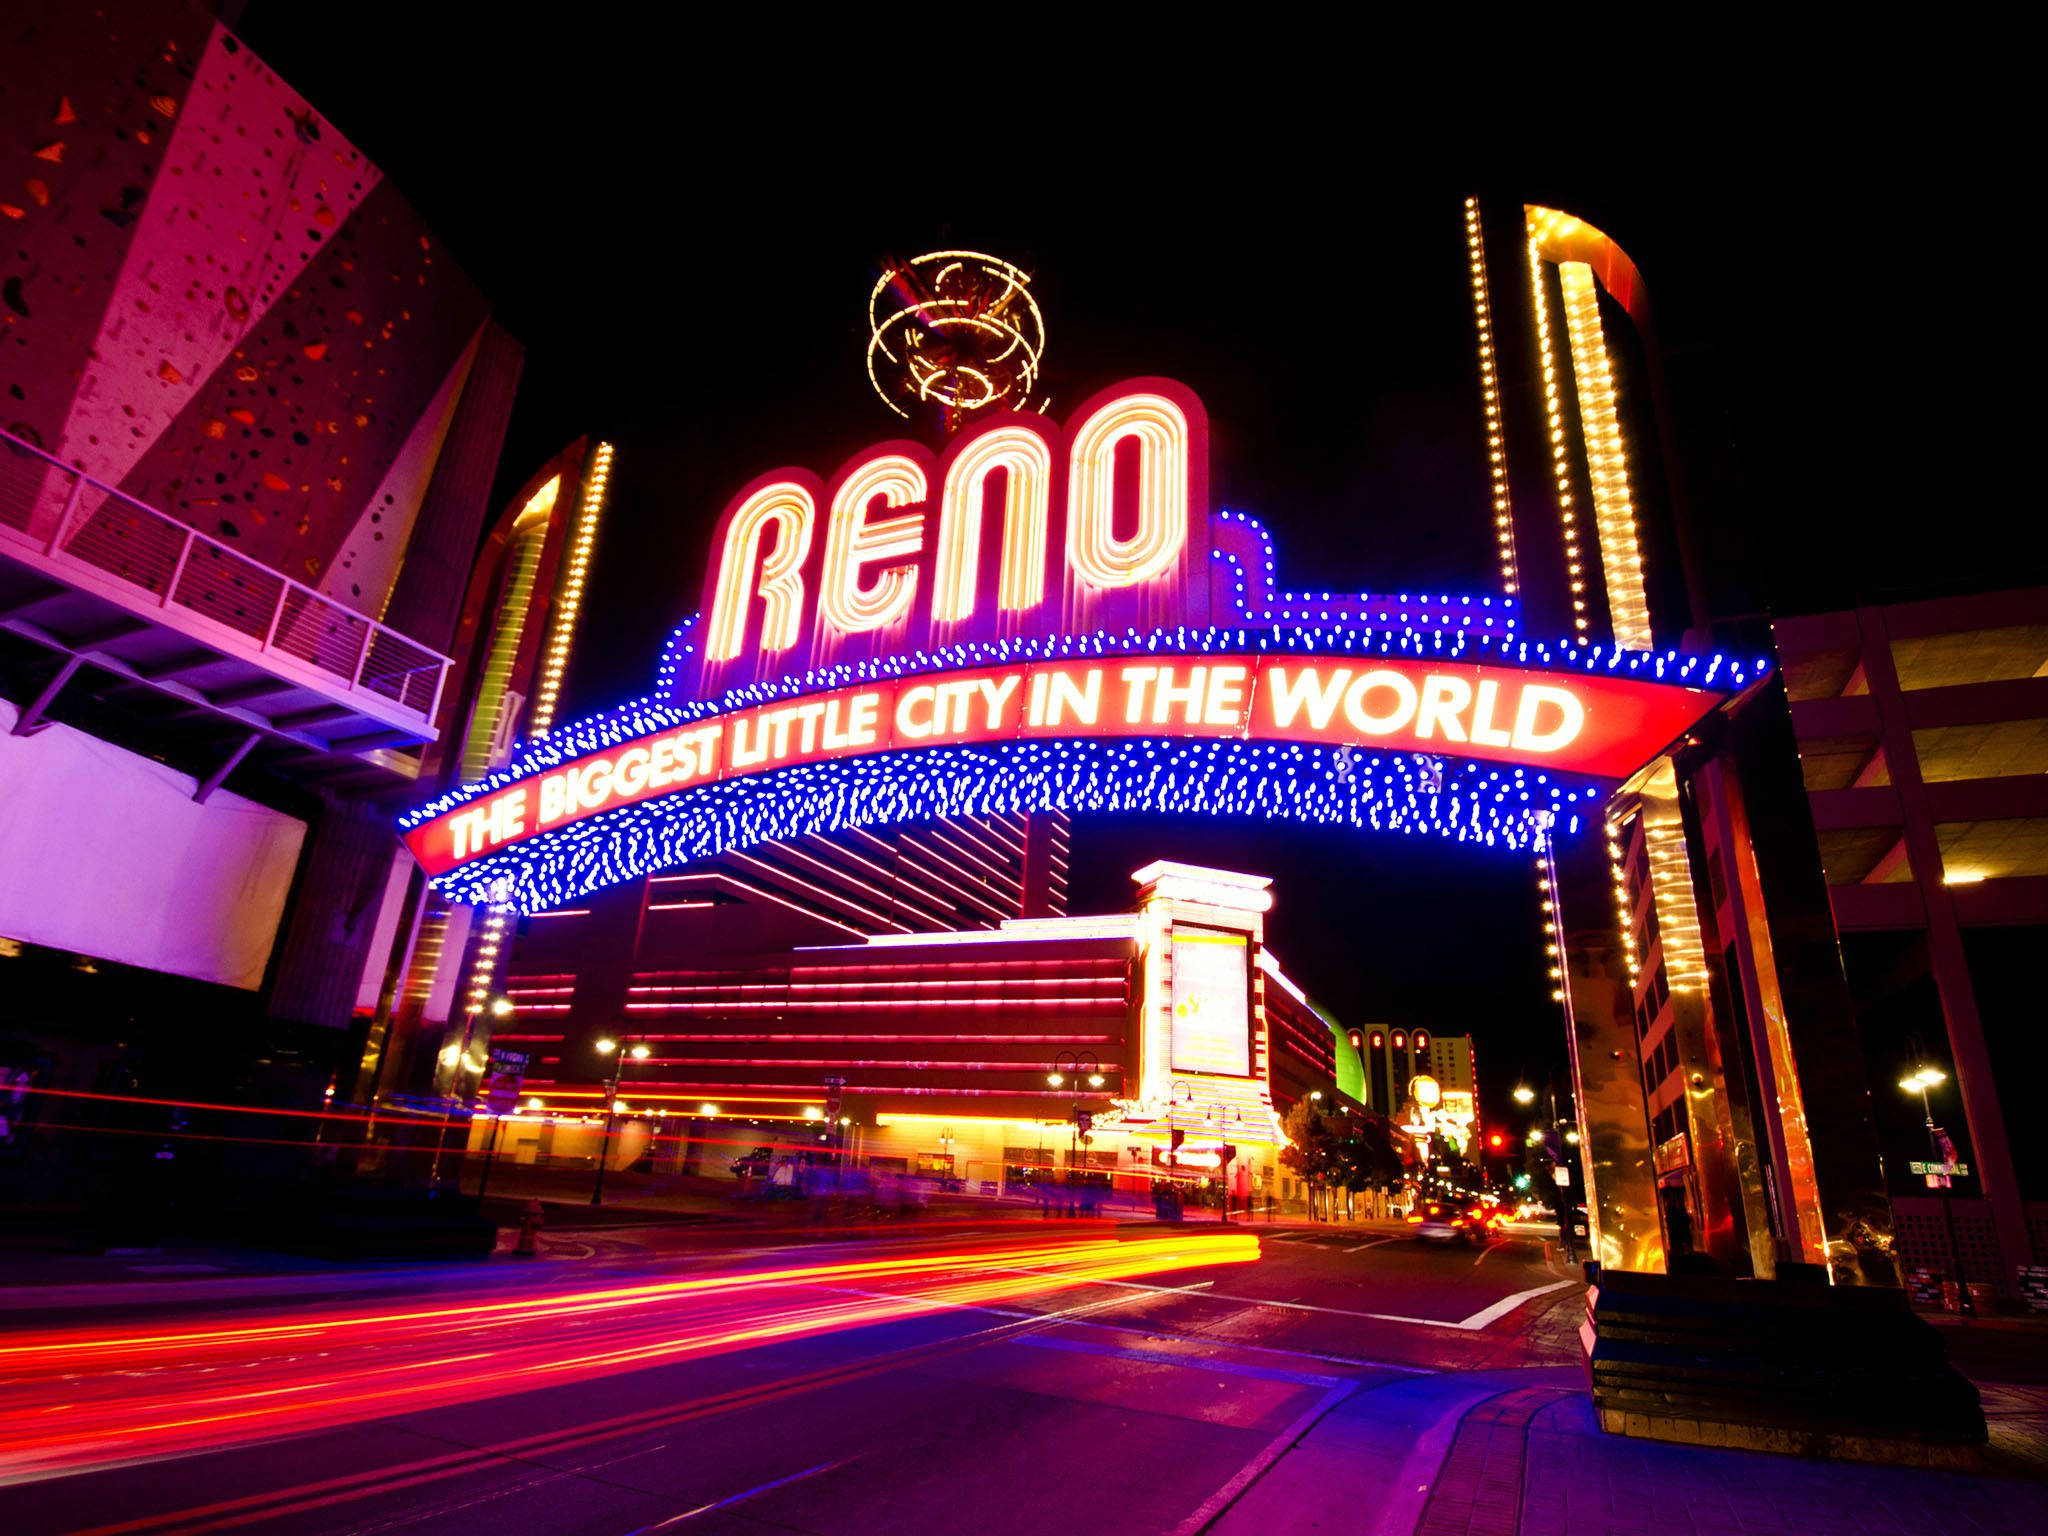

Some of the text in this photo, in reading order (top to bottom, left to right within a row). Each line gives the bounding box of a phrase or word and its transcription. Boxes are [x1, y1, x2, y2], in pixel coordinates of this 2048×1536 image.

[702, 389, 1191, 664] RENO
[447, 664, 1588, 860] THE BIGGEST LITTLE CITY IN THE WORLD
